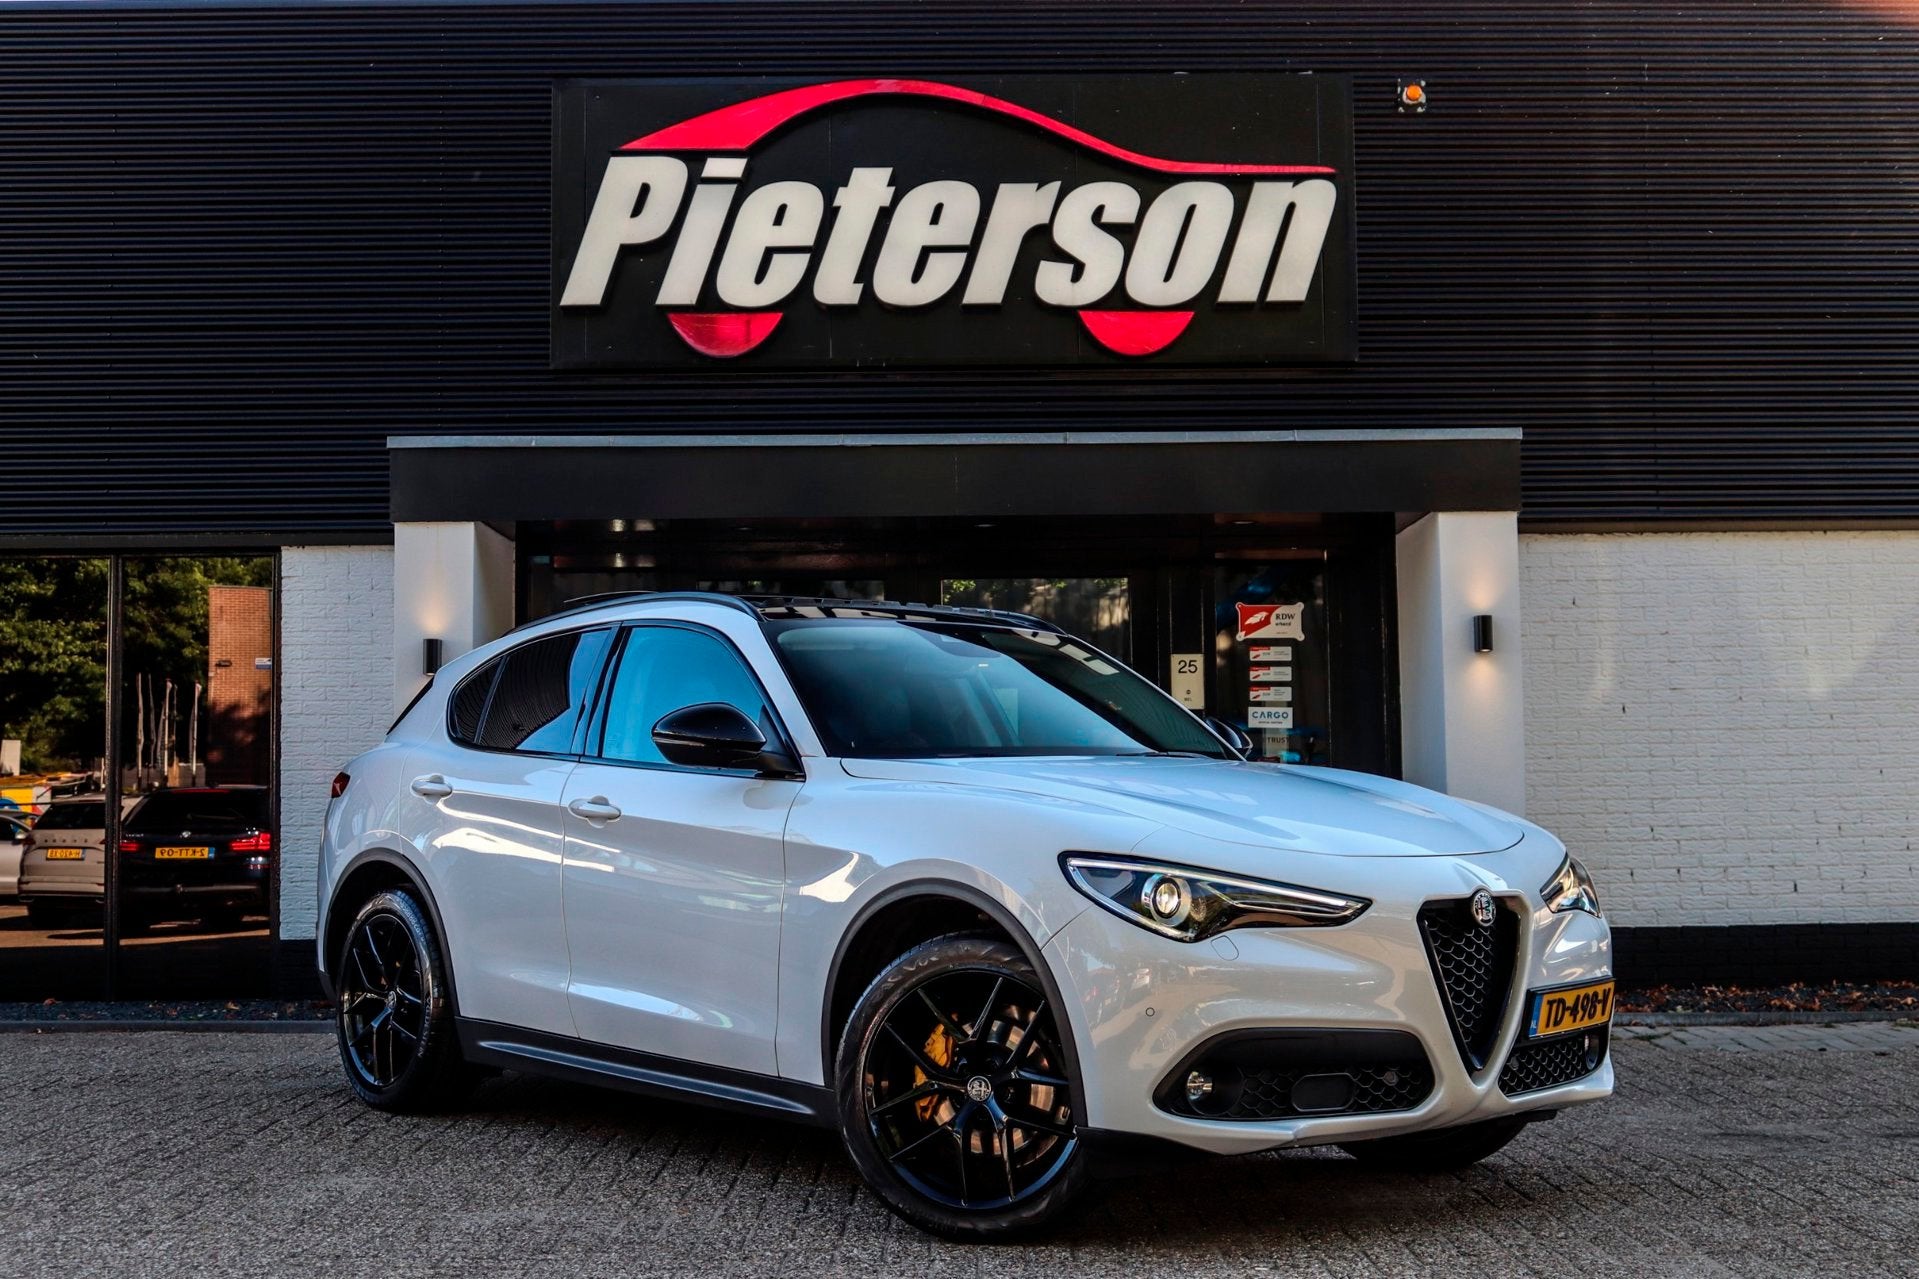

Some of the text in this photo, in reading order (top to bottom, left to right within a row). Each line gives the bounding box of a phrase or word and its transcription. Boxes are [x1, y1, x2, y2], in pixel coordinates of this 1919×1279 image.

[560, 156, 1337, 307] Pieterson
[1177, 659, 1198, 674] 25
[1252, 711, 1289, 719] CARGO
[1545, 987, 1611, 1029] TD-498-V
